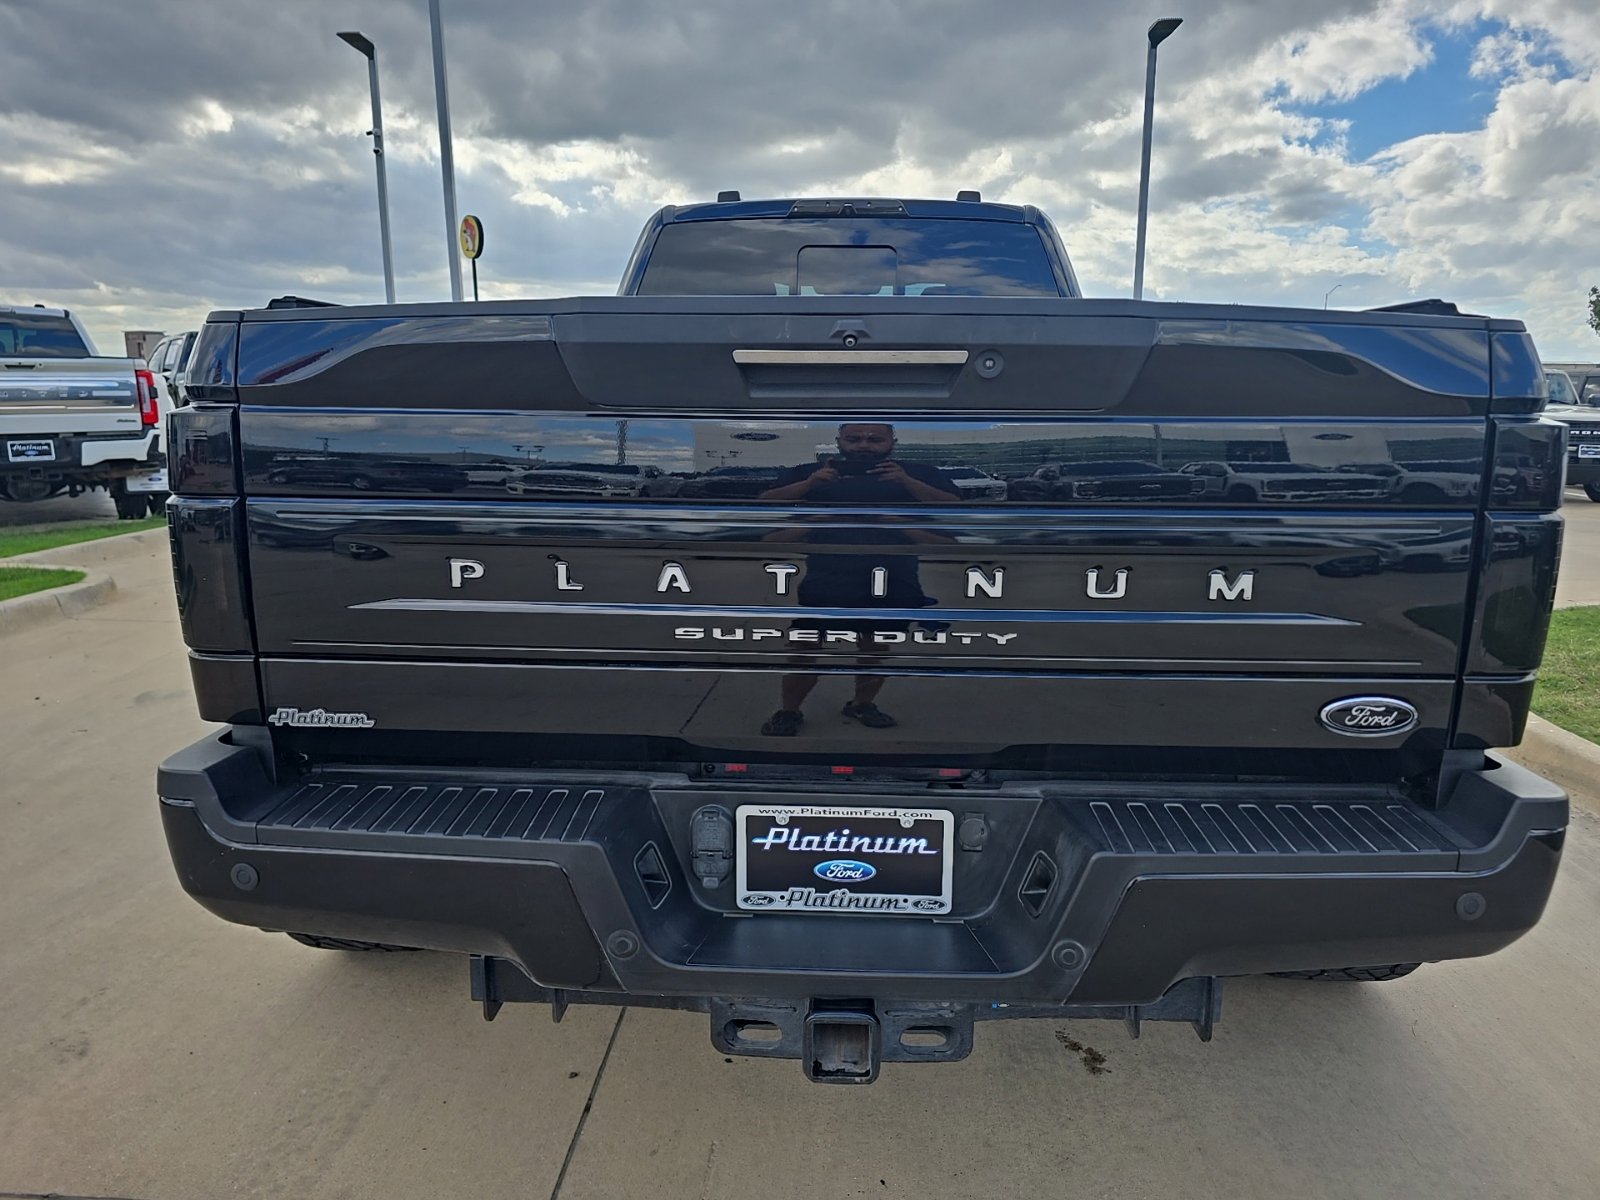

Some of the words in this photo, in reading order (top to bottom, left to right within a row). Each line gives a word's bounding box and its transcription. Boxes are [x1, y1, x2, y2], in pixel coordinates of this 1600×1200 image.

[449, 558, 1255, 601] PLATINUM
[268, 708, 376, 728] Platinum
[1344, 705, 1398, 726] Ford
[758, 807, 933, 818] www.PlatinumFord.com
[751, 827, 940, 855] Platinum
[826, 863, 864, 879] Ford
[747, 895, 769, 905] Ford
[784, 889, 908, 910] Platinum
[918, 900, 940, 910] Ford
